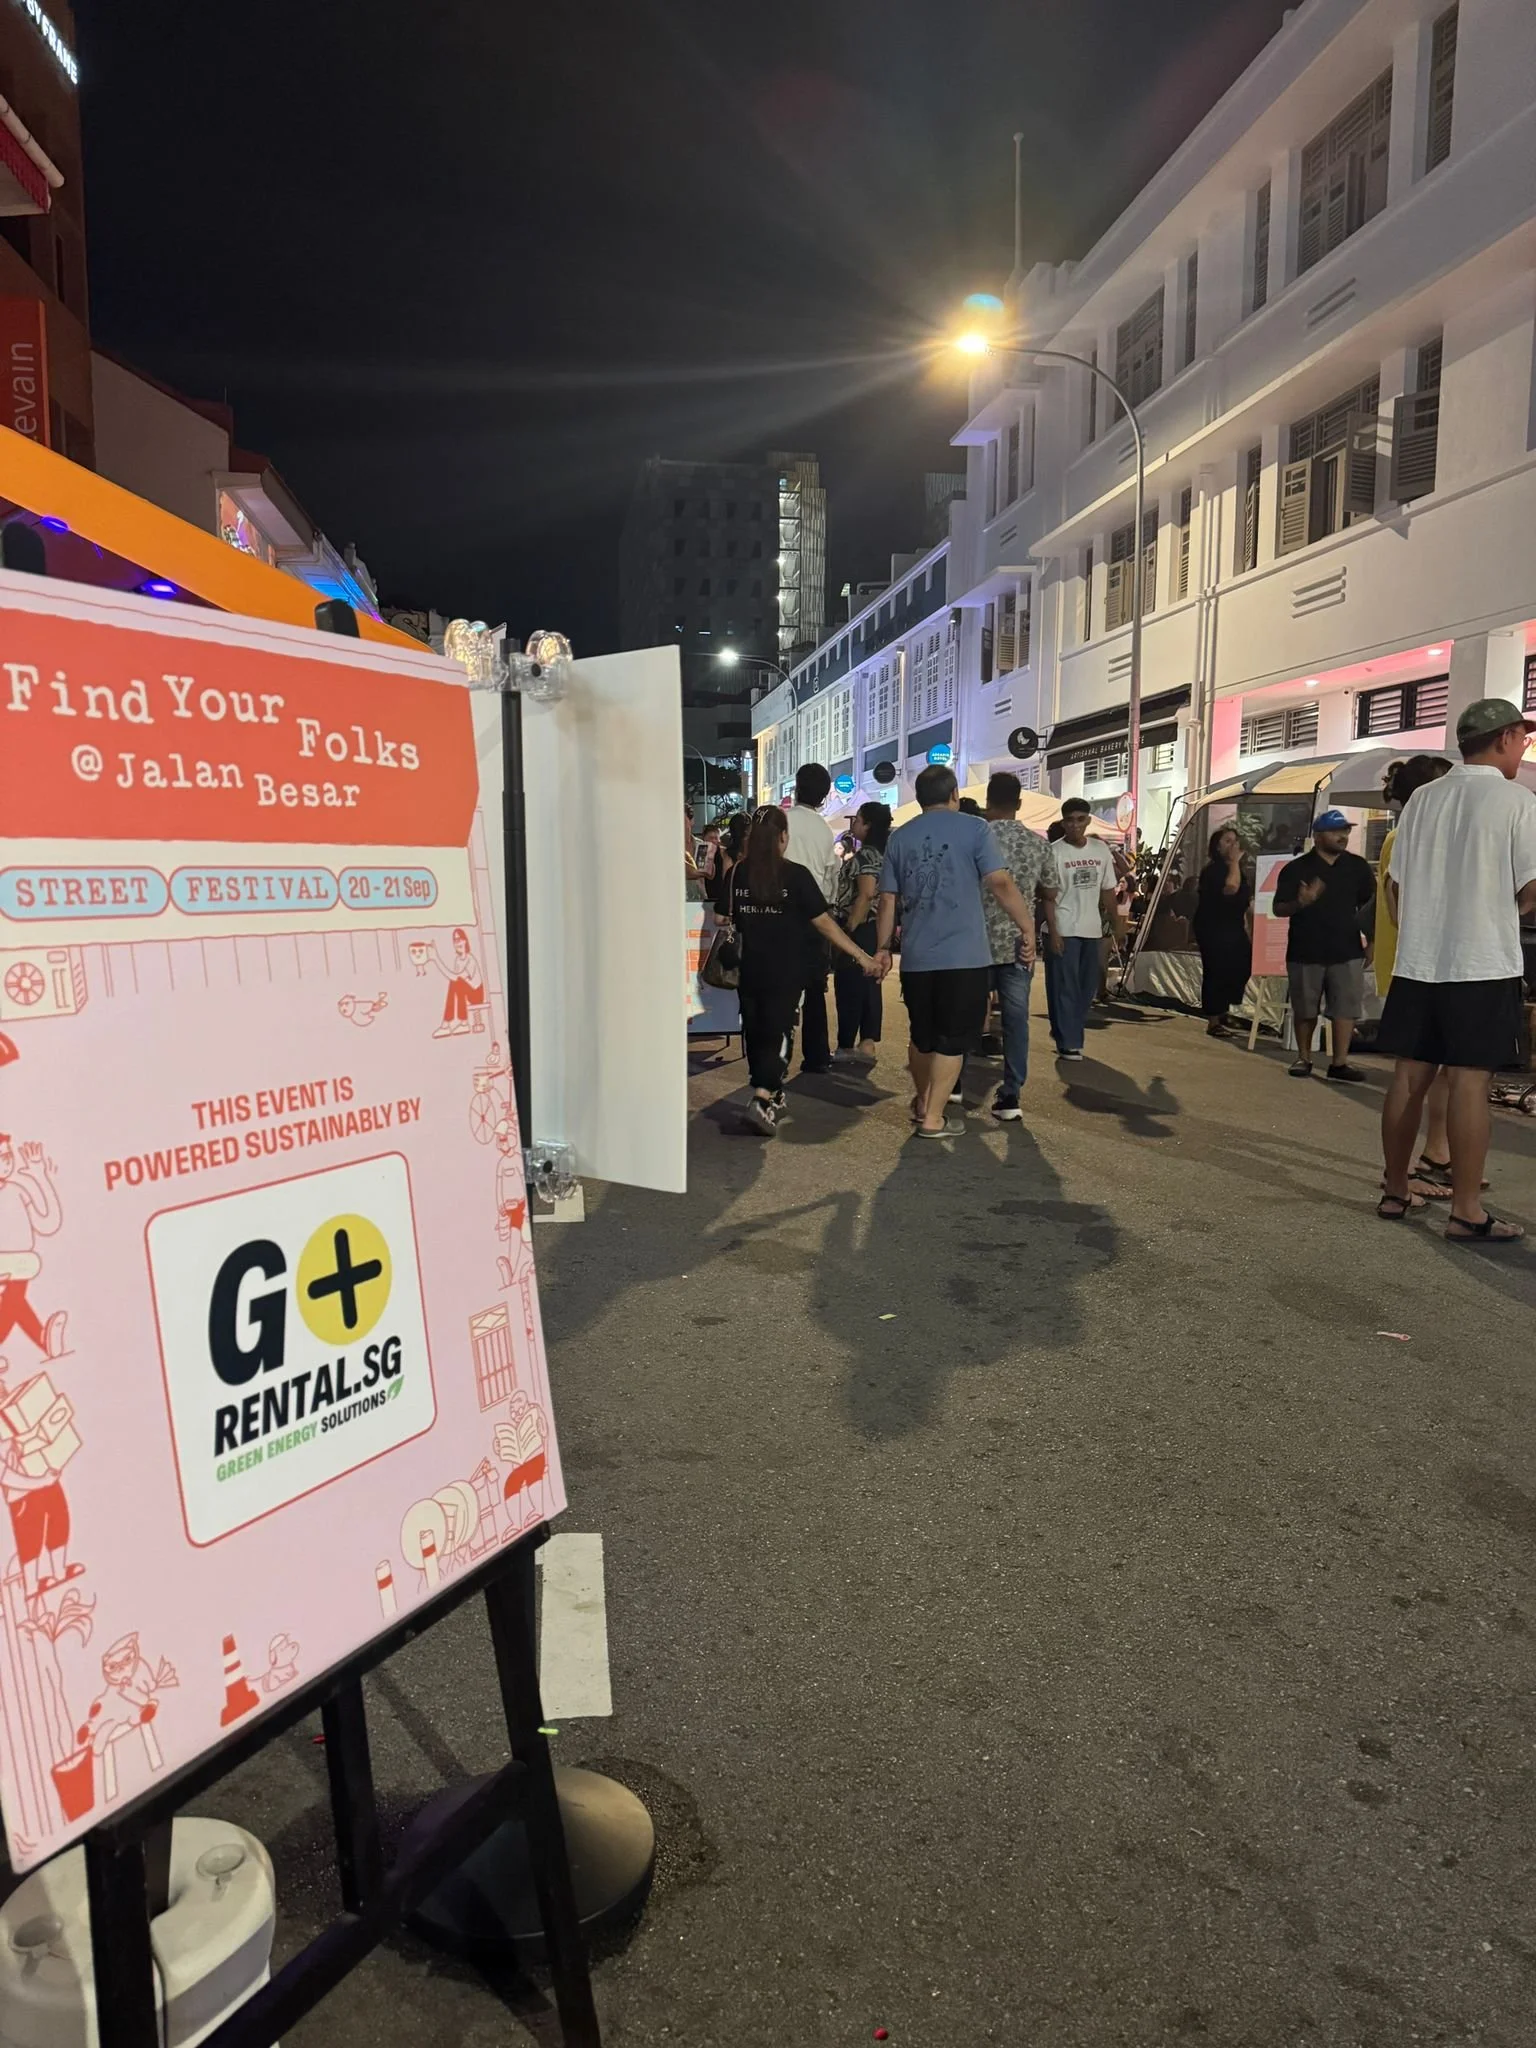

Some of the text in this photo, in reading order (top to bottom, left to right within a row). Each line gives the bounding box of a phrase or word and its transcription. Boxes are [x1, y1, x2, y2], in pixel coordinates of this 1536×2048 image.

[11, 343, 38, 440] evain
[3, 662, 421, 771] Find Your Folks
[71, 744, 361, 807] @ Jalan Besar
[15, 877, 150, 908] STREET
[186, 875, 330, 902] FESTIVAL
[403, 876, 431, 902] Sep
[104, 1098, 421, 1190] POWERED SUSTAINABLY BY
[191, 1077, 354, 1130] THIS EVENT IS
[214, 1336, 402, 1458] RENTAL.SG
[216, 1389, 386, 1482] GREEN ENERGY SOLUTIONS
